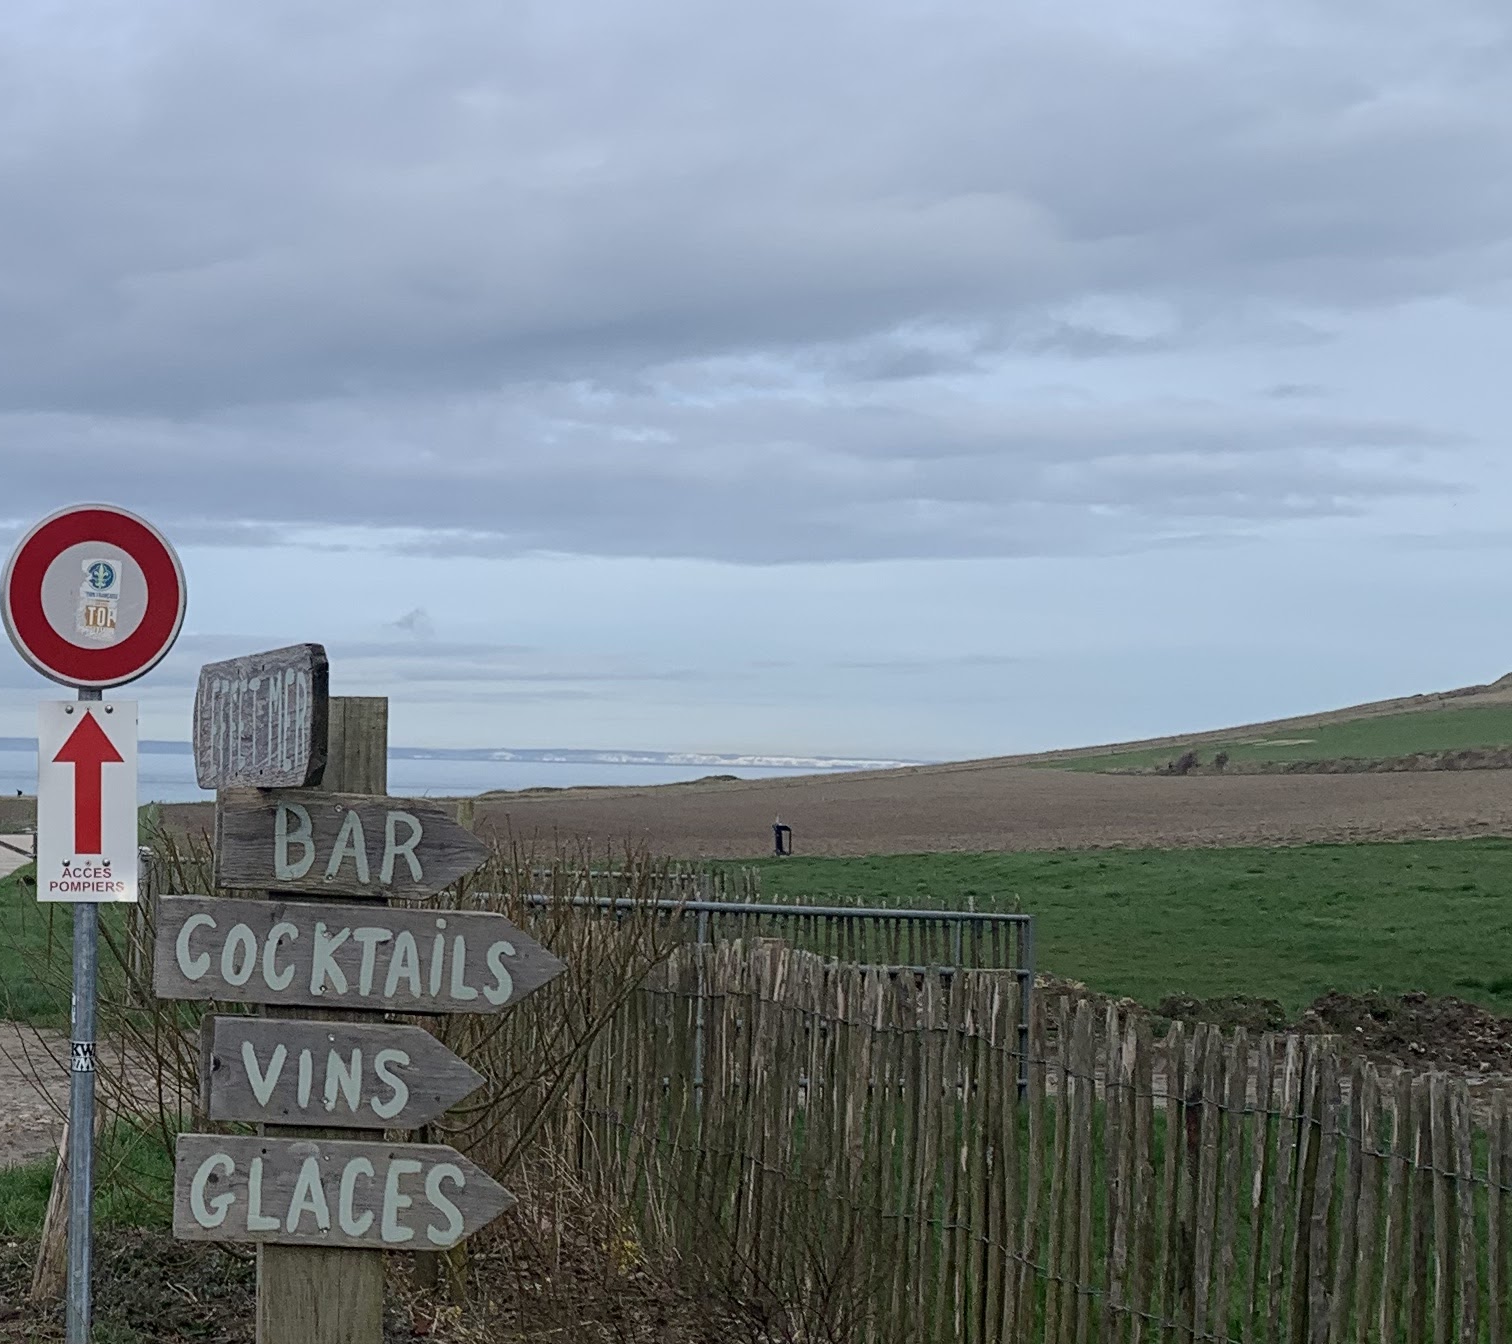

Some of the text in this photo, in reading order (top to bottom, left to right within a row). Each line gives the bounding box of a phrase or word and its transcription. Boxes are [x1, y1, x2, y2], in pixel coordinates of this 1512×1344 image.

[267, 667, 308, 772] MER
[61, 867, 112, 879] ACCES
[274, 800, 423, 884] BAR
[49, 881, 125, 893] POMPIERS
[241, 1040, 410, 1120] VINS
[190, 1153, 466, 1246] GLACES
